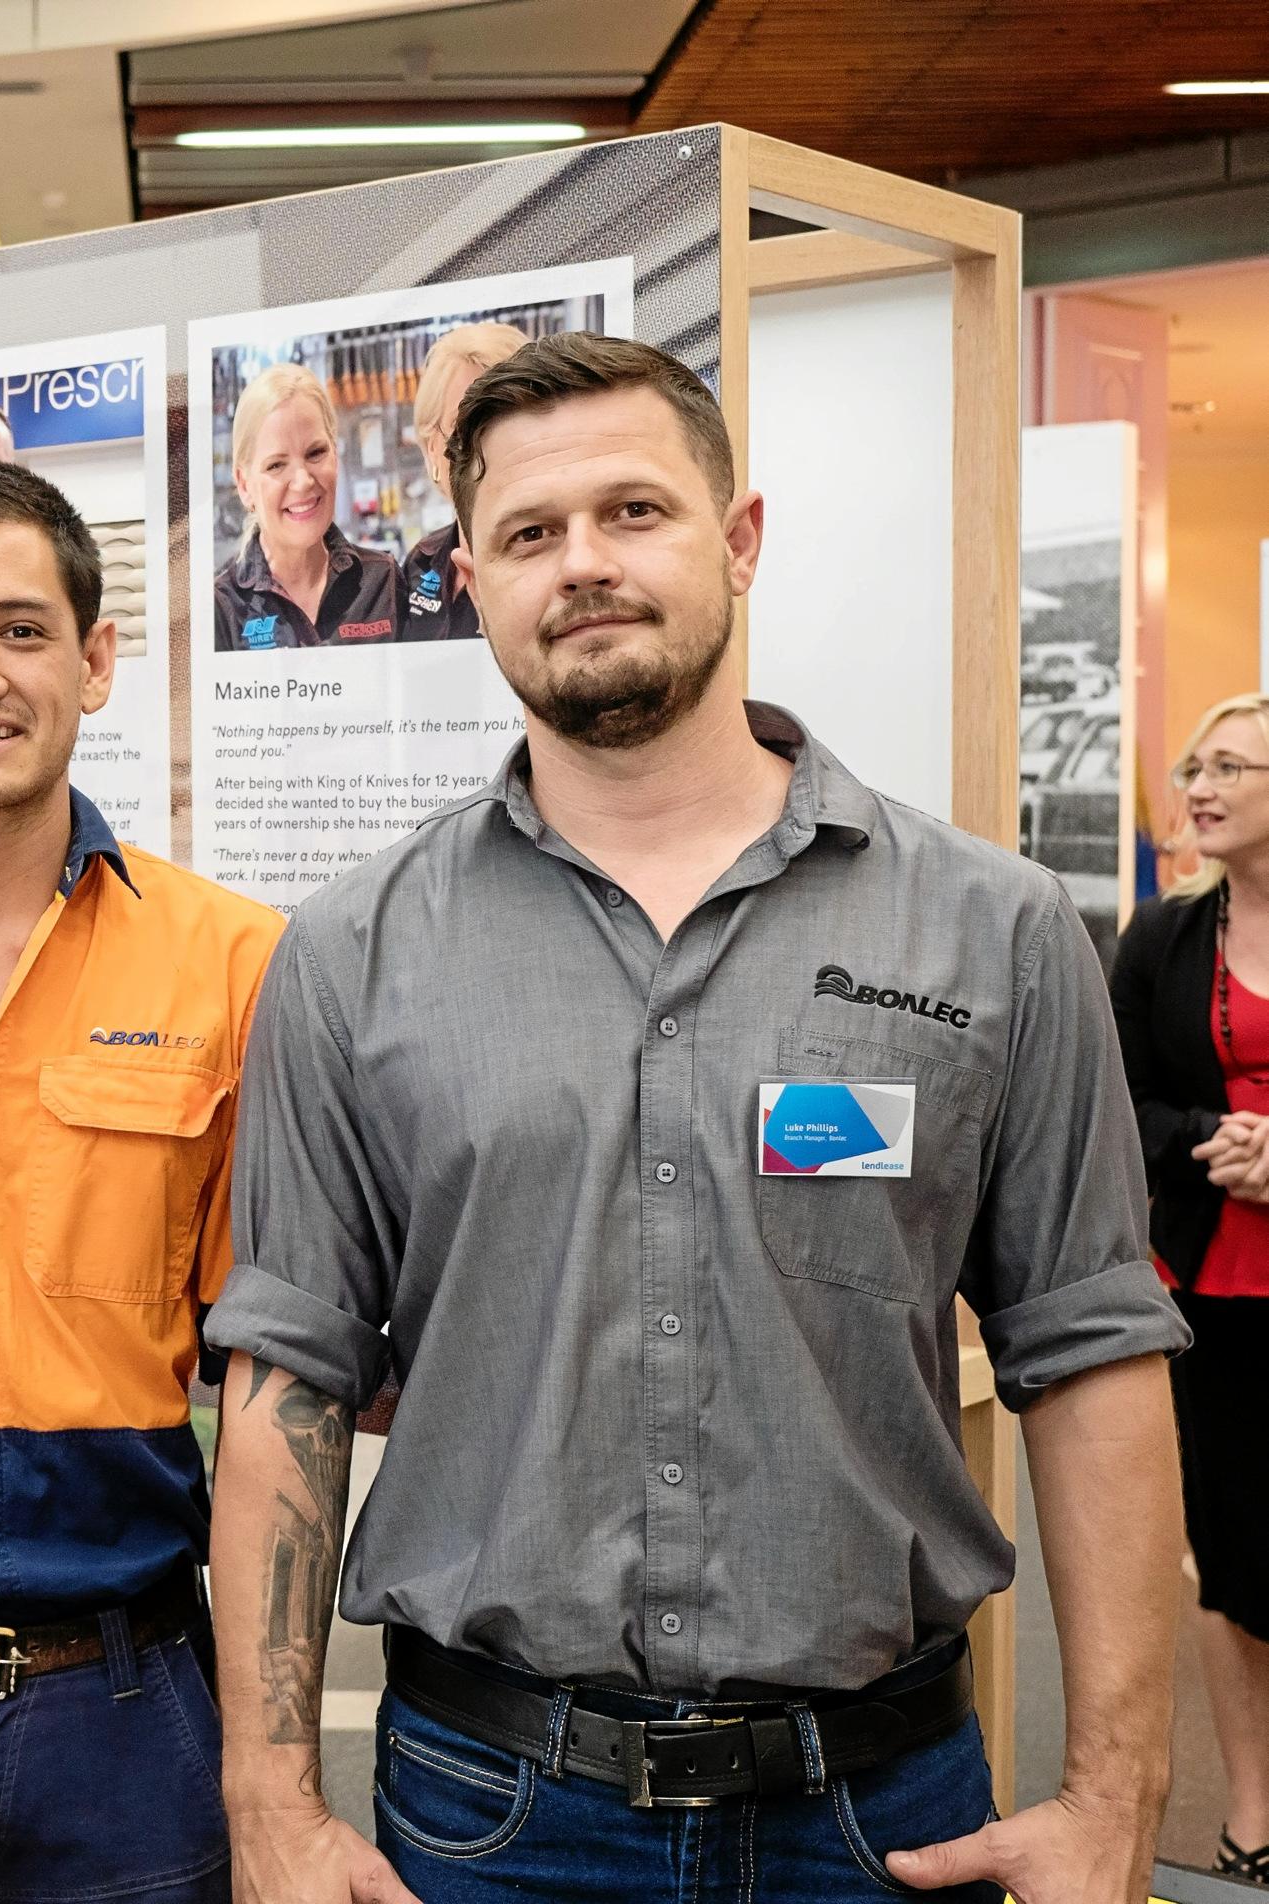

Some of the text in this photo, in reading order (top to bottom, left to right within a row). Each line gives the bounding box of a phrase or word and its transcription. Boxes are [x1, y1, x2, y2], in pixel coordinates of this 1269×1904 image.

[215, 679, 342, 702] Maxine Payne
[267, 723, 319, 739] happens
[323, 721, 337, 738] by
[341, 720, 394, 738] yourself,
[398, 719, 416, 733] it's
[421, 718, 441, 732] the
[446, 720, 479, 732] team
[484, 719, 507, 734] you
[99, 731, 122, 742] now
[80, 749, 119, 762] exactly
[123, 748, 141, 760] the
[215, 745, 257, 758] around
[215, 773, 488, 792] After being with King of Knives for 12 years
[99, 799, 113, 811] its
[115, 798, 139, 811] kind
[215, 797, 263, 809] decided
[267, 796, 288, 809] she
[291, 796, 338, 809] wanted
[342, 798, 355, 809] to
[359, 796, 382, 811] buy
[387, 796, 408, 809] the
[119, 820, 131, 830] at
[214, 816, 419, 832] years of ownership she has never
[263, 851, 296, 862] never
[300, 852, 308, 862] a
[311, 850, 334, 864] day
[338, 849, 371, 862] when
[216, 869, 248, 881] work.
[252, 869, 256, 881] I
[259, 869, 295, 884] spend
[299, 872, 330, 882] more
[855, 985, 972, 1029] BONLEC
[109, 1031, 206, 1049] BONLEC
[784, 1123, 839, 1133] Luke Phillips
[861, 1161, 904, 1170] lendlease
